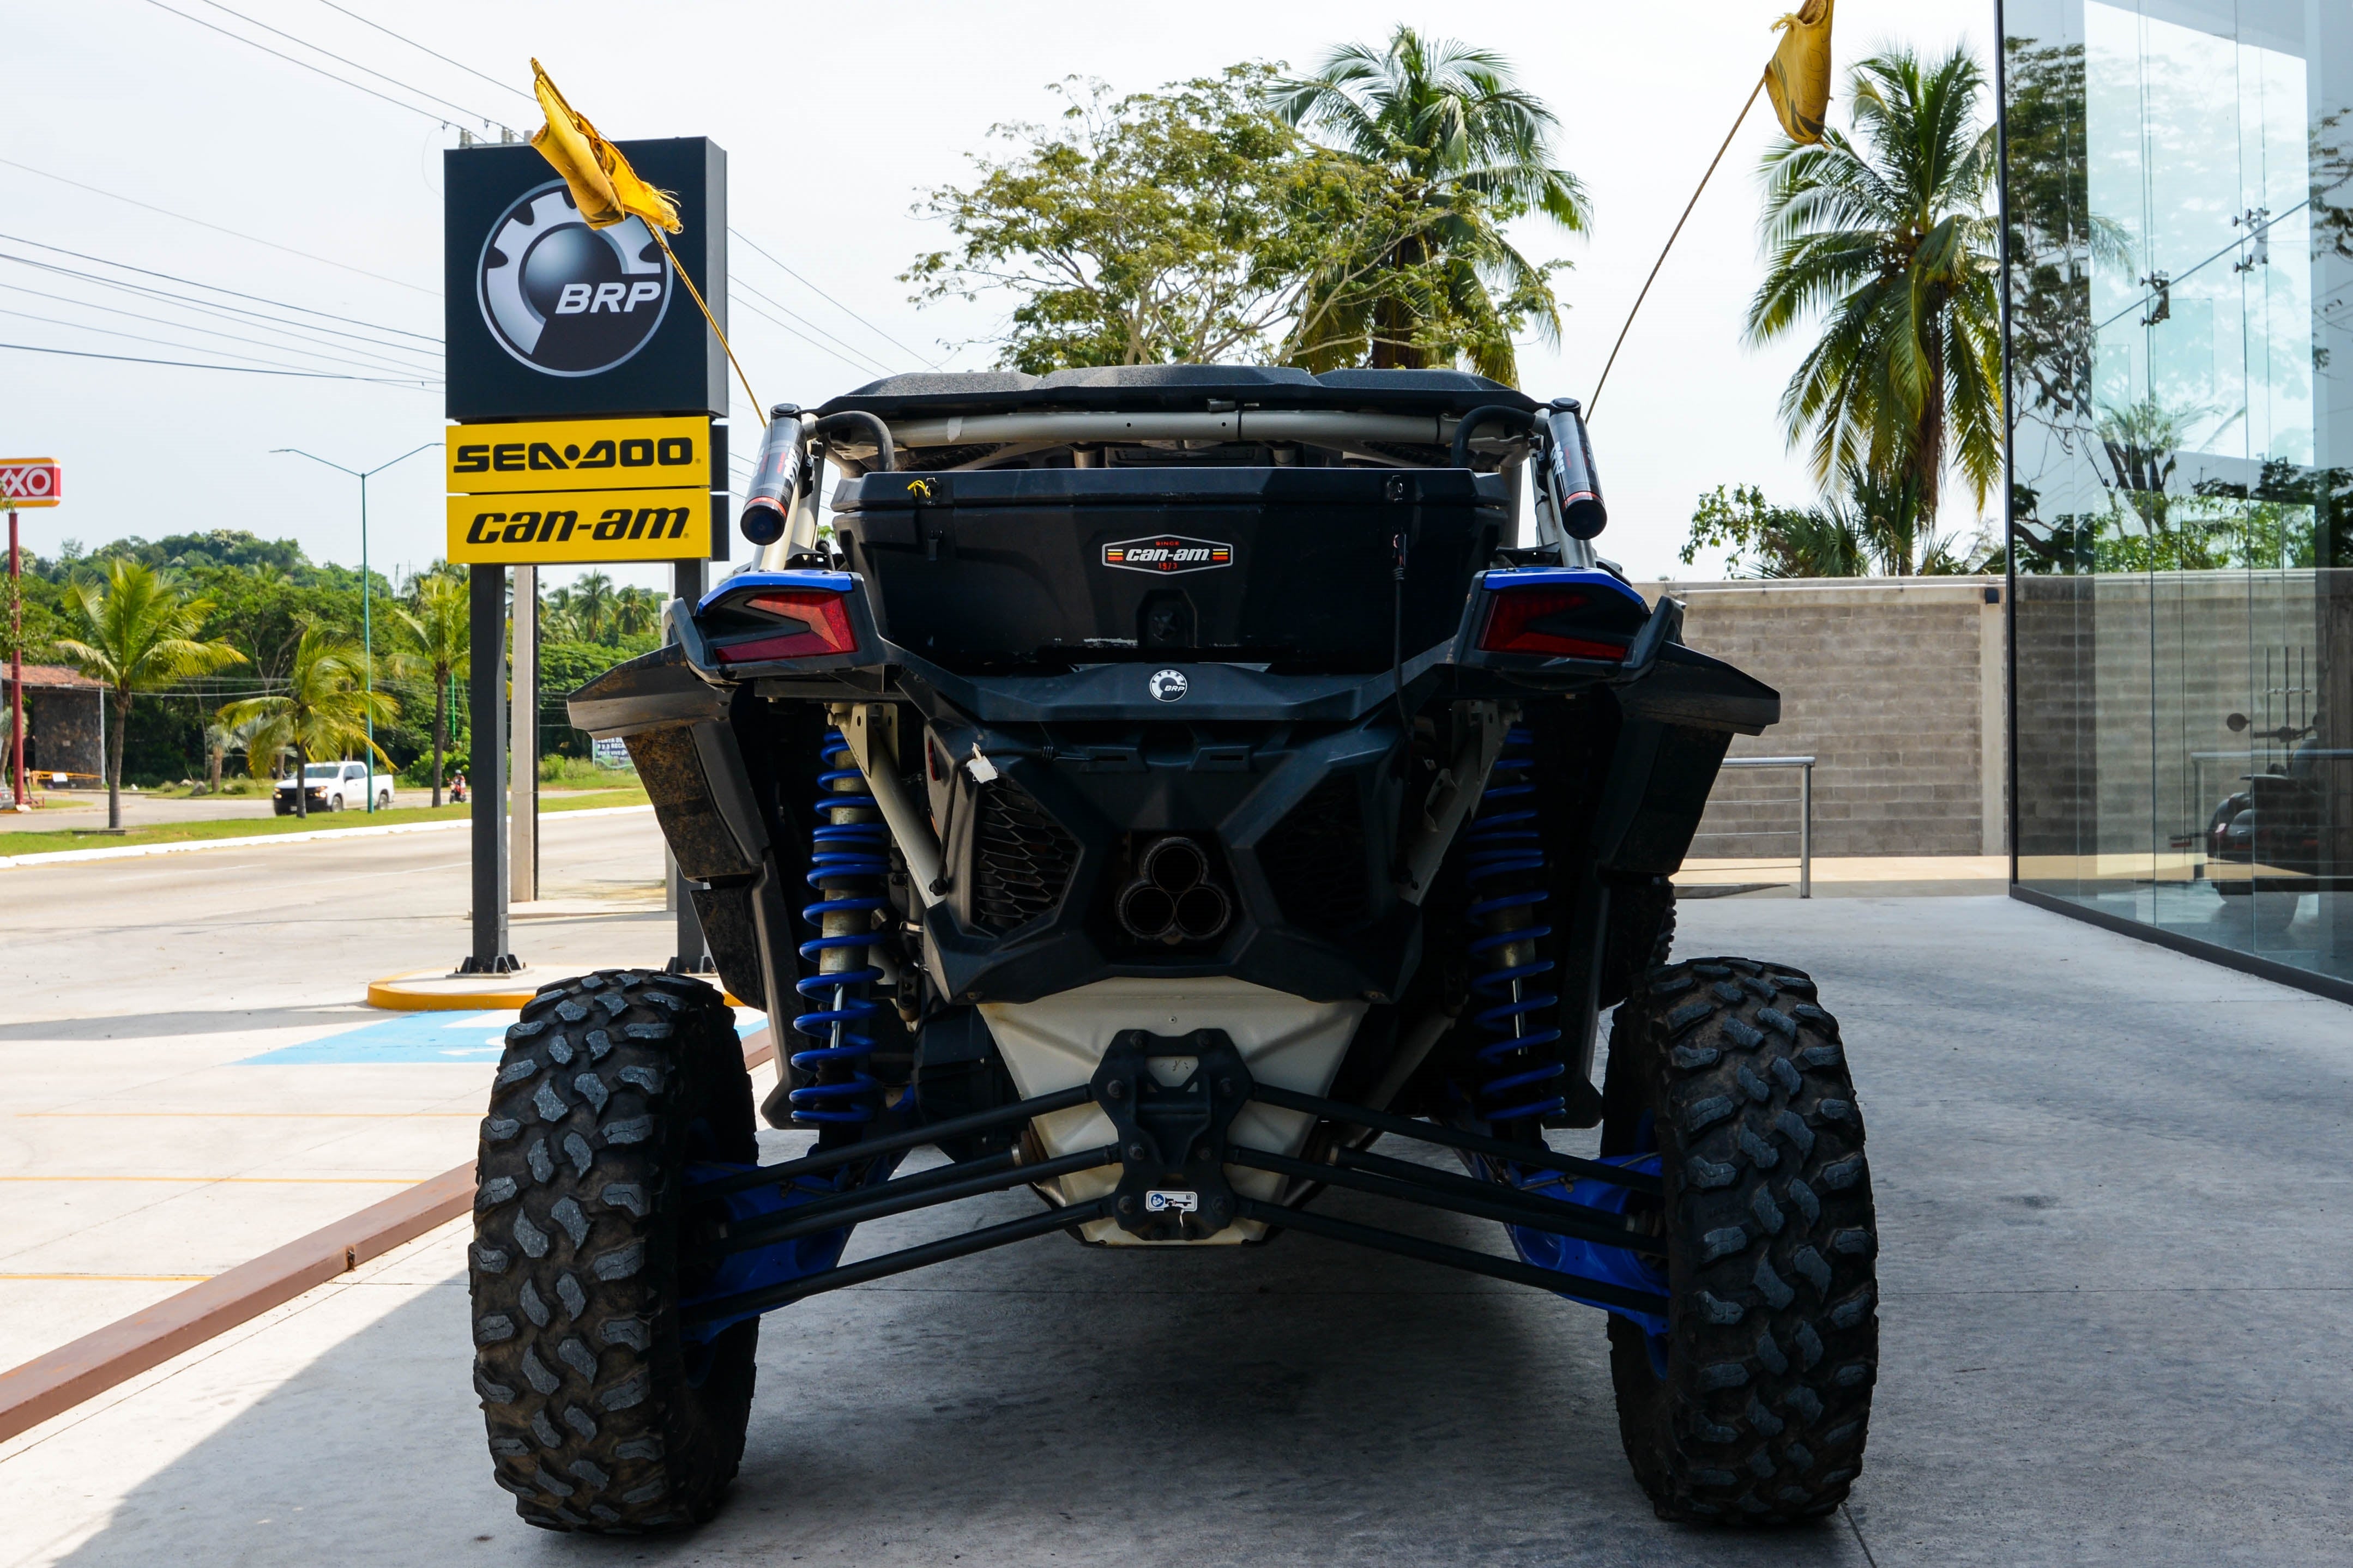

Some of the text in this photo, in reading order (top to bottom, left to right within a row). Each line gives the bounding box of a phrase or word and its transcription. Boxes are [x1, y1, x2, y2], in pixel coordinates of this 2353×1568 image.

[556, 282, 661, 314] BRP
[467, 507, 690, 544] can-am
[1126, 549, 1210, 561] can-am
